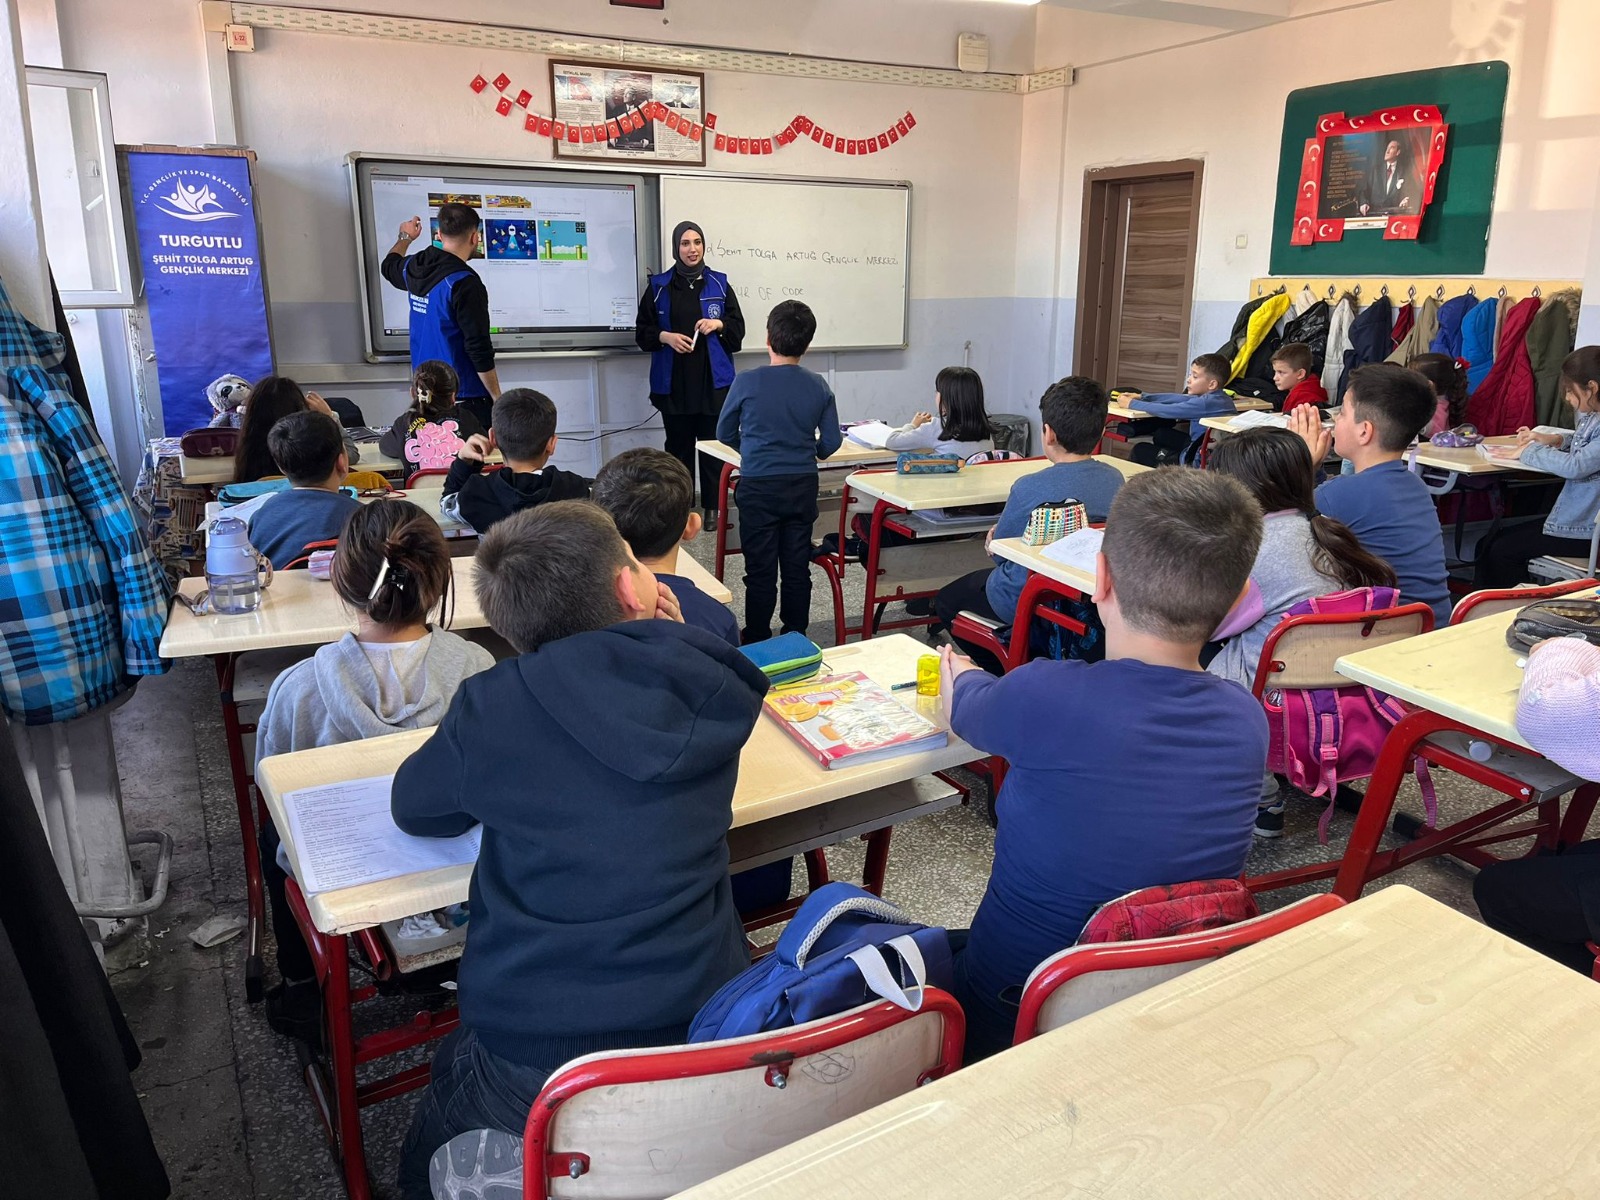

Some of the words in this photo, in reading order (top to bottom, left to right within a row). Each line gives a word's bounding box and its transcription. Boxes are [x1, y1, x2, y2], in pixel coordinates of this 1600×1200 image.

[189, 169, 210, 178] SPOR
[159, 234, 243, 249] TURGUTLU
[152, 253, 181, 265] ŞEHİT
[183, 255, 218, 264] TOLGA
[747, 248, 777, 260] TOLGA
[160, 264, 205, 276] GENÇLİK
[206, 265, 249, 276] MERKEZİ
[758, 286, 772, 301] OF
[781, 286, 804, 296] CODE
